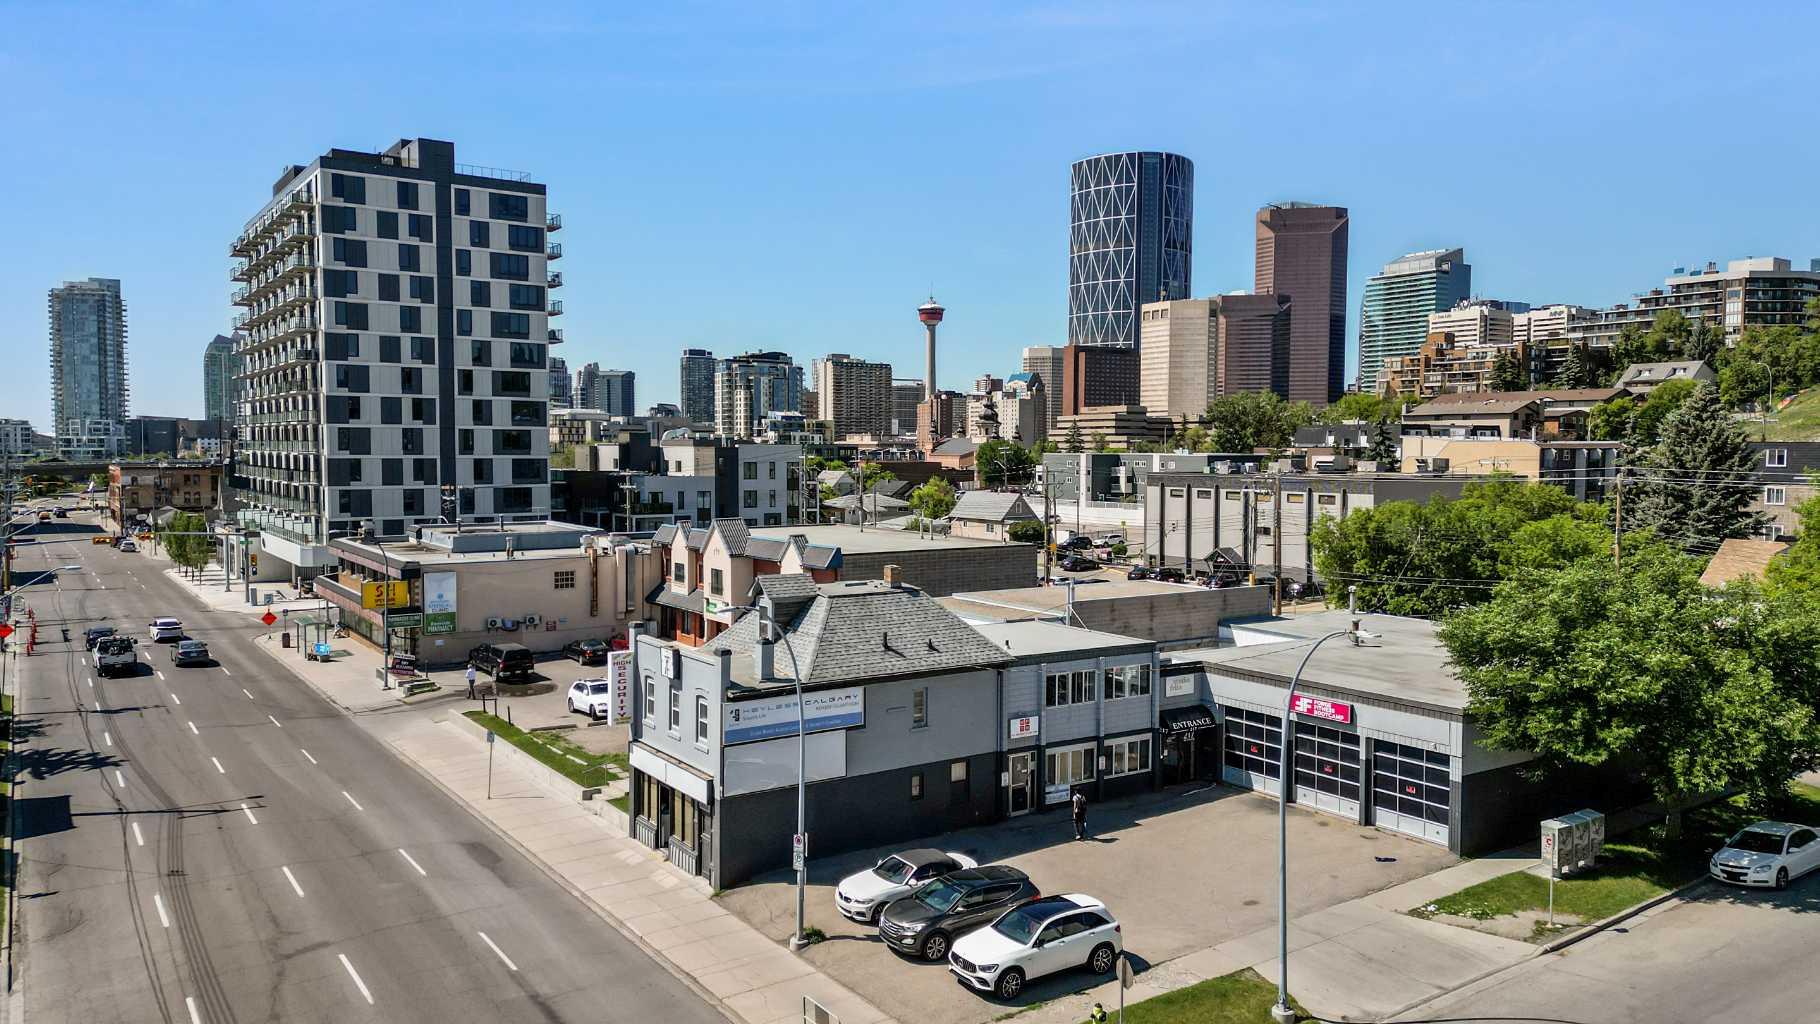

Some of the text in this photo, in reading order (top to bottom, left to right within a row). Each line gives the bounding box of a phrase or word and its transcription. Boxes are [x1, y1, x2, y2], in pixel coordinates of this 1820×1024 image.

[617, 666, 627, 718] SECURITY
[804, 694, 859, 706] CALGARY
[1313, 710, 1345, 721] BOOTCAMP
[1172, 717, 1212, 730] ENTRANCE
